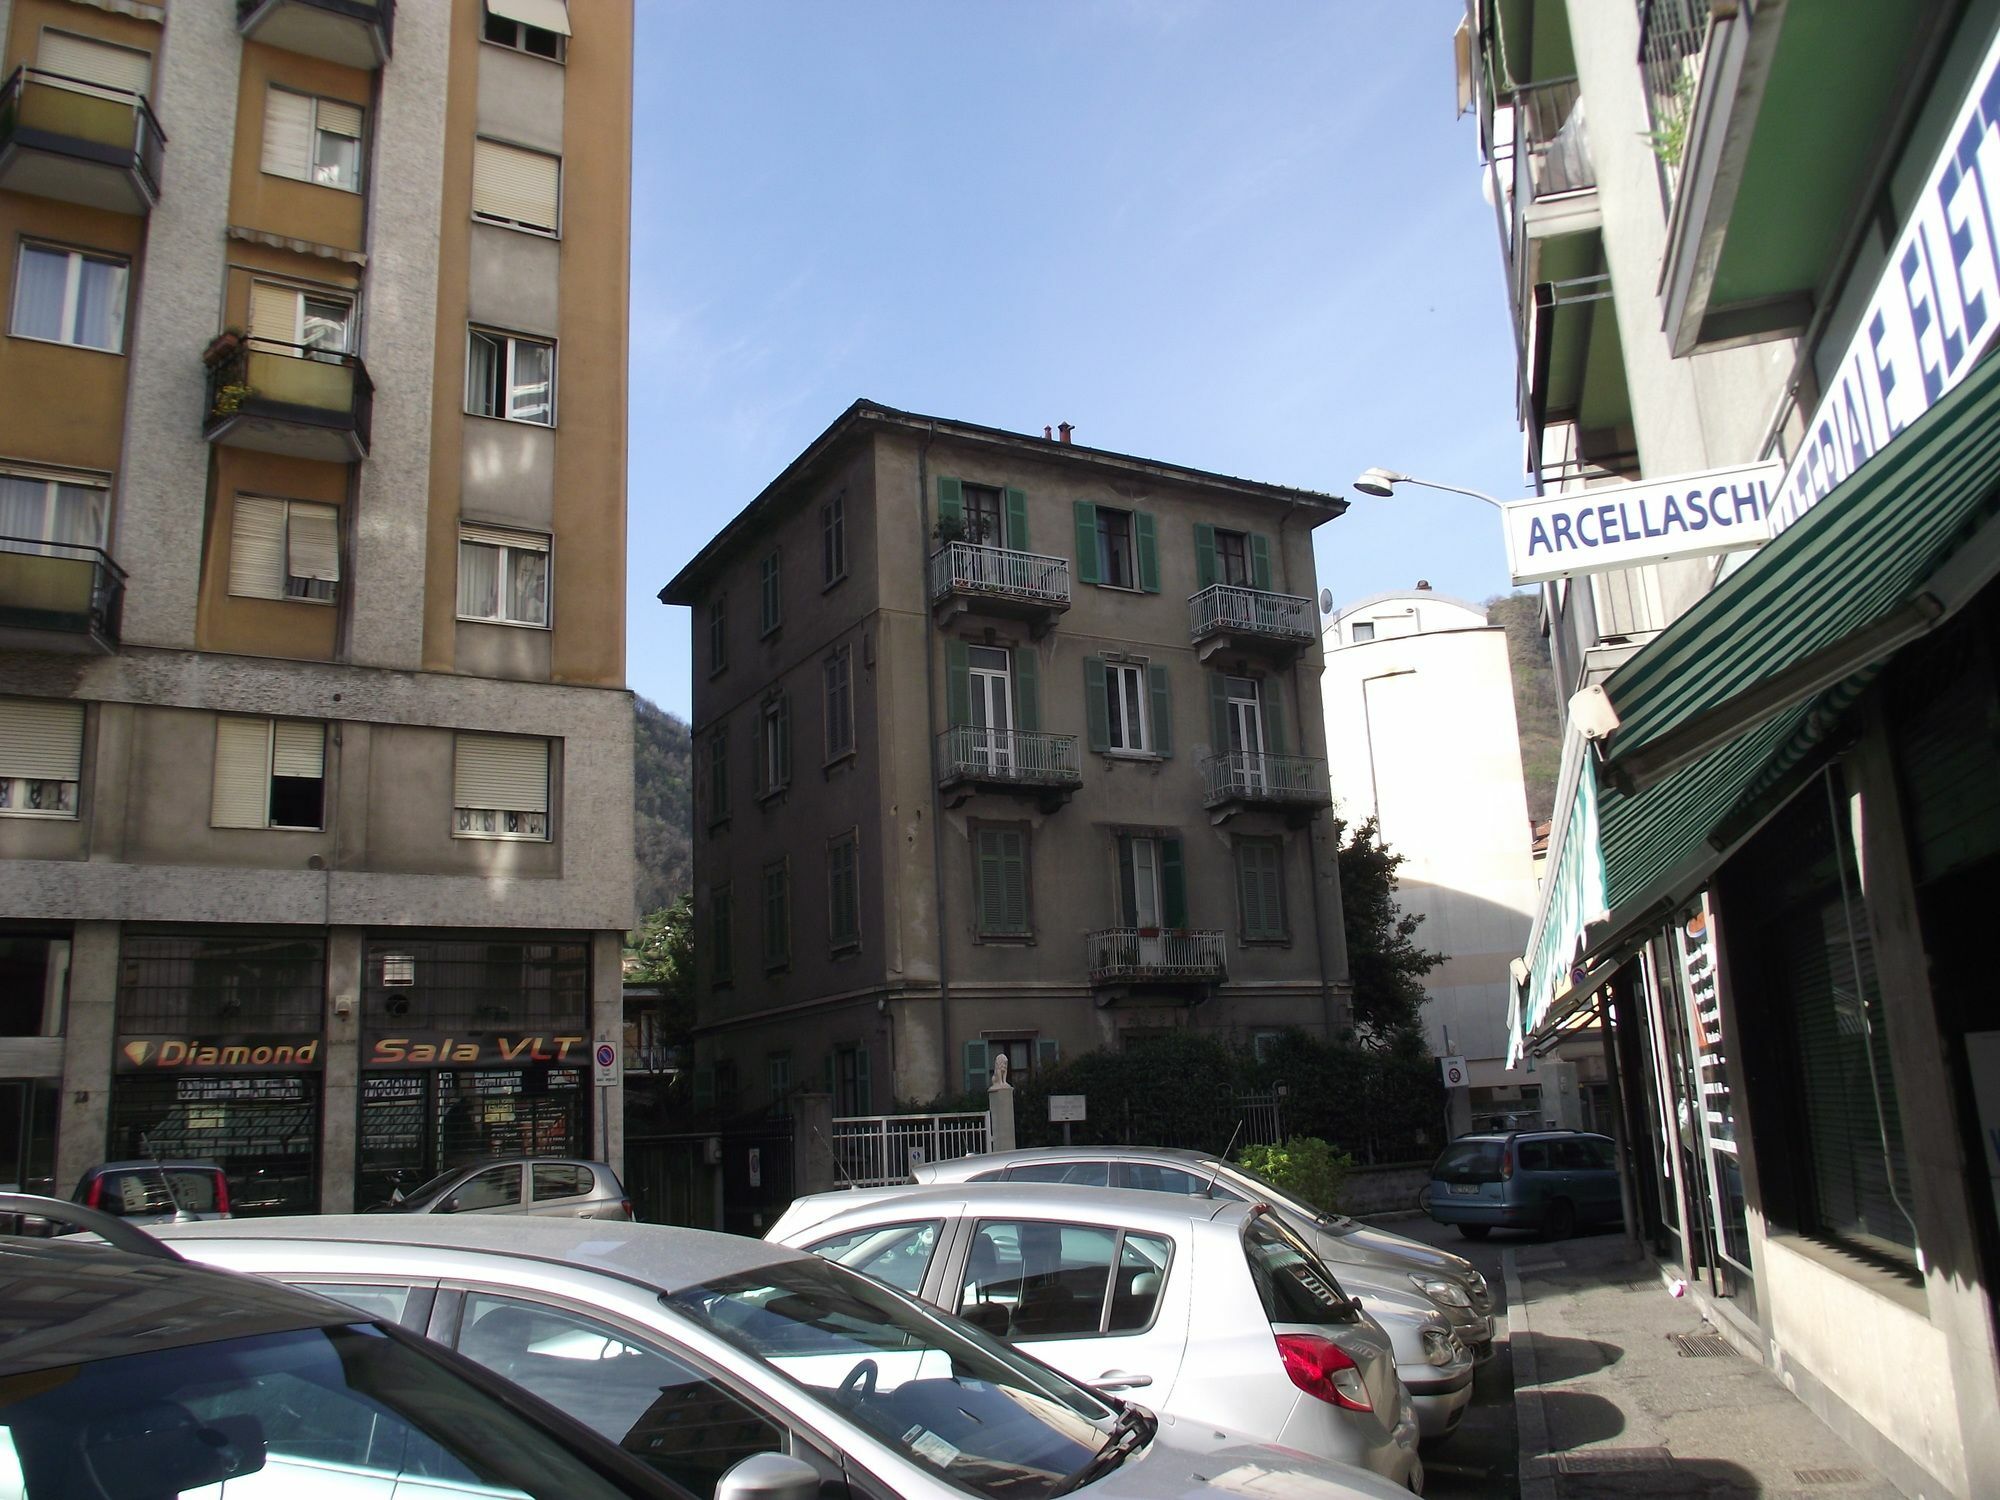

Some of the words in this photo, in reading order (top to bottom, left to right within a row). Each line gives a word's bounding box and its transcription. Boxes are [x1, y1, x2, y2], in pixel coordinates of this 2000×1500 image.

[1901, 68, 2000, 407] ELET
[1528, 480, 1769, 556] ARCELLASCHI
[157, 1039, 318, 1066] Diamond
[371, 1038, 480, 1063] Sala
[498, 1036, 583, 1062] VLT
